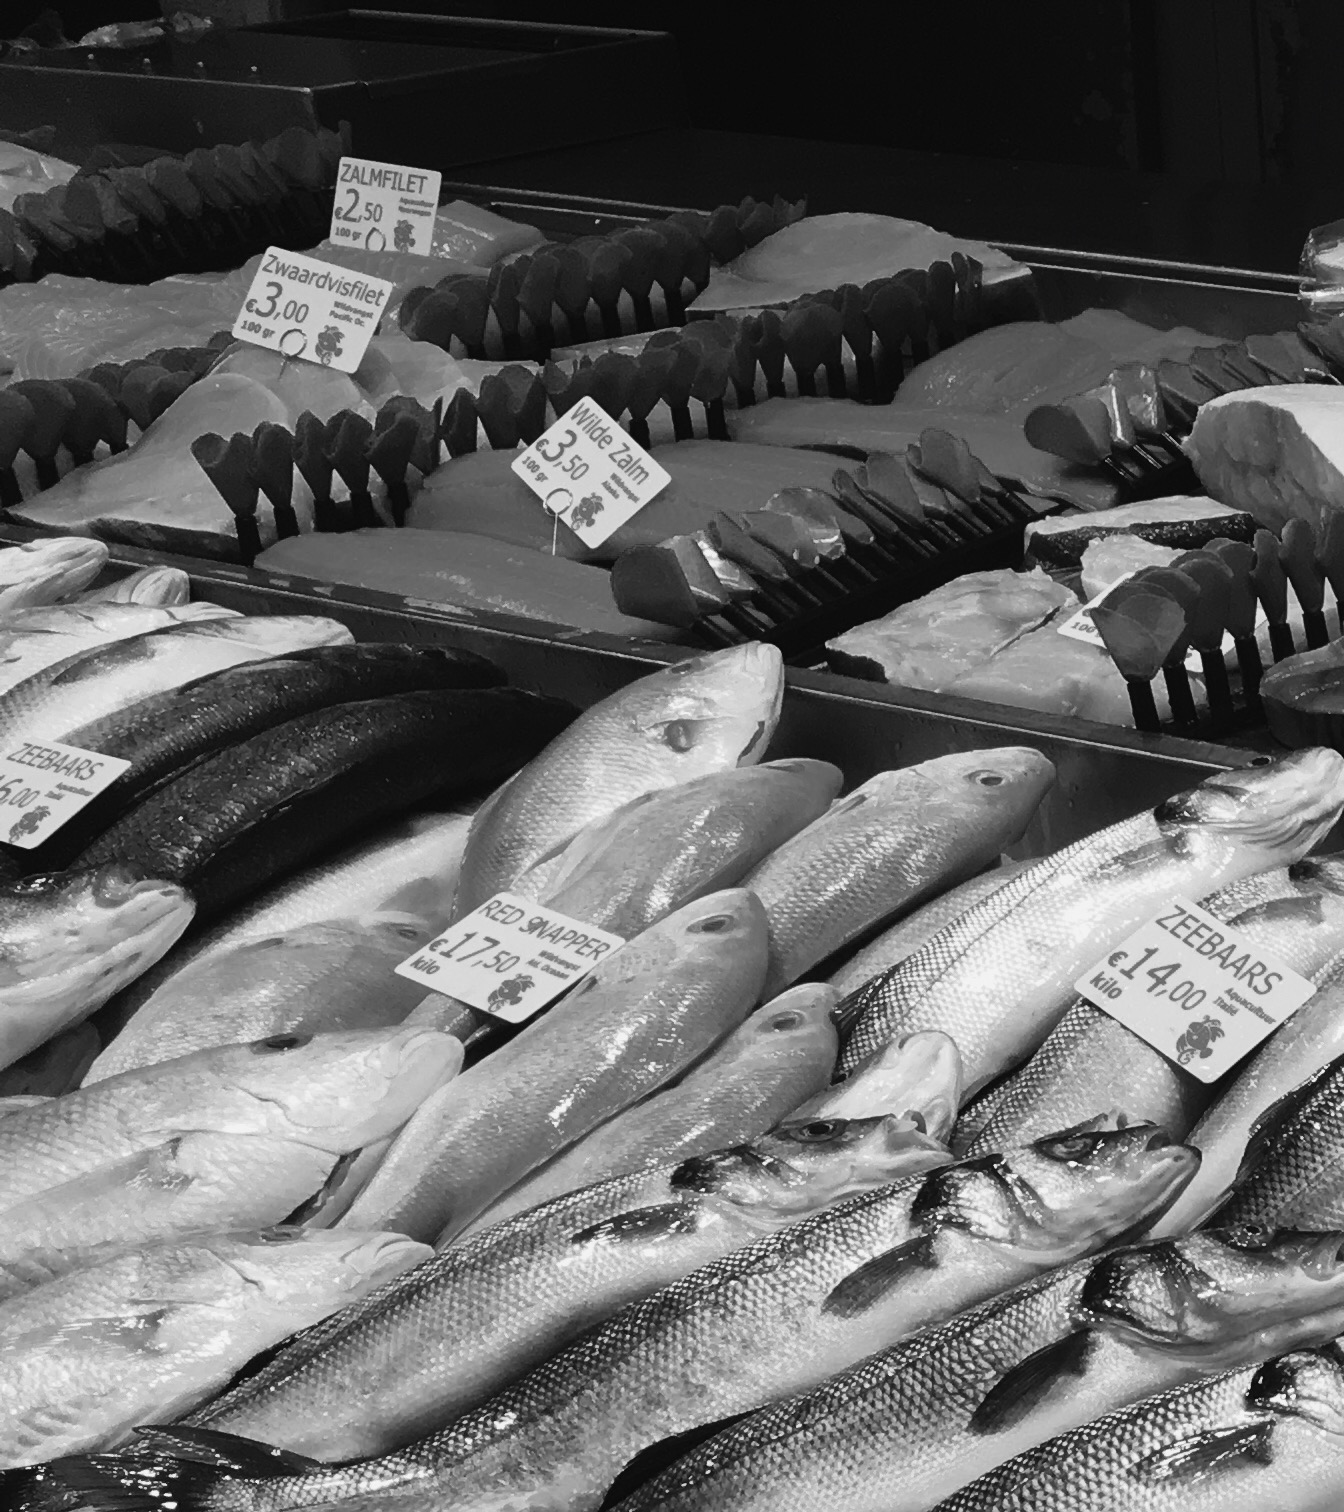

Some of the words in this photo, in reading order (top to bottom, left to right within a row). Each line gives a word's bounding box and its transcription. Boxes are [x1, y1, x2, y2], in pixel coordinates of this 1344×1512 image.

[340, 163, 428, 194] ZALMFILET
[335, 227, 351, 238] 100
[352, 232, 362, 241] gr
[262, 254, 385, 306] Zwaardvisfilet
[241, 320, 262, 334] 100
[262, 328, 276, 339] gr
[570, 402, 613, 450] Wilde
[608, 442, 650, 486] Zalm
[521, 456, 540, 473] 100
[534, 472, 549, 482] gr
[6, 742, 104, 780] ZEEBAARS
[478, 899, 525, 925] RED
[518, 916, 611, 961] SNAPPER
[409, 955, 440, 975] kilo
[1155, 904, 1283, 995] ZEEBAARS
[1089, 971, 1123, 1000] kilo
[1223, 987, 1277, 1025] Aquacultuur
